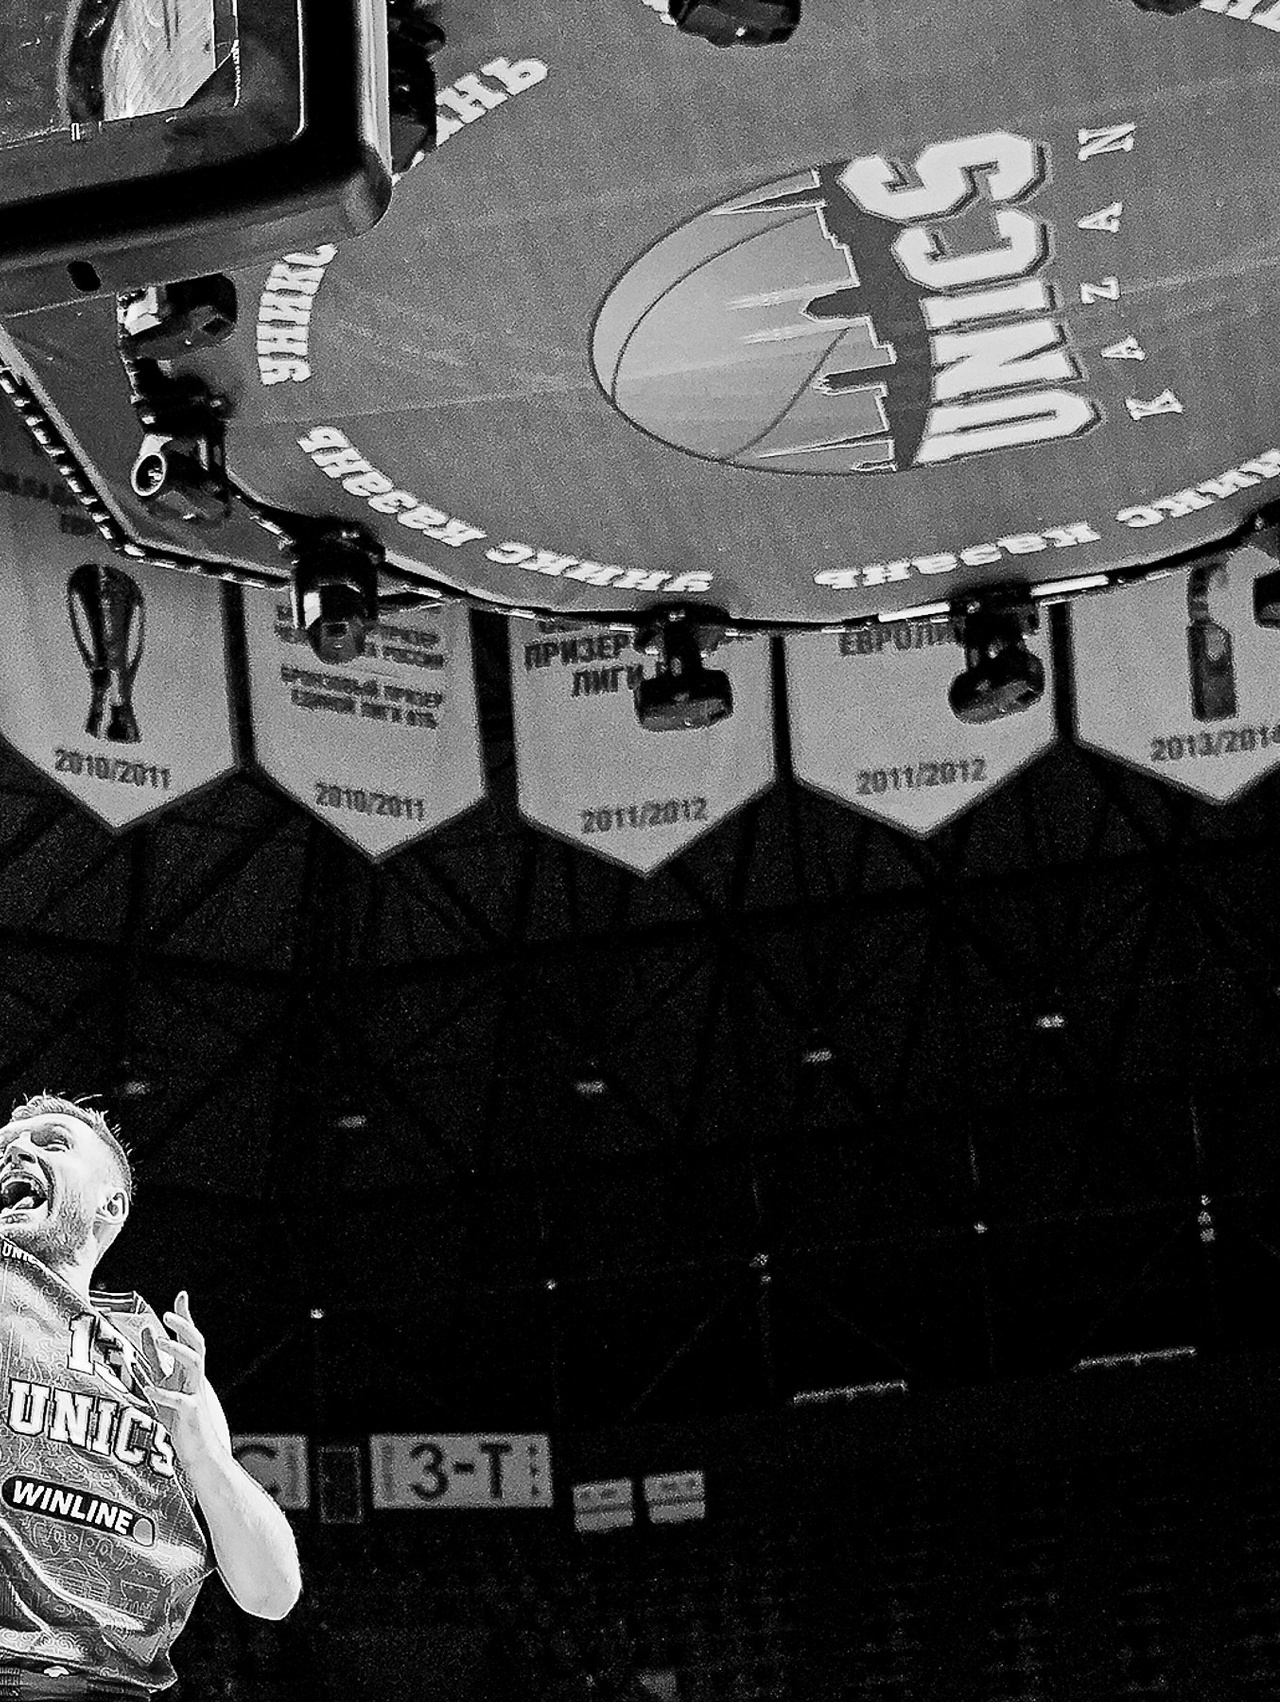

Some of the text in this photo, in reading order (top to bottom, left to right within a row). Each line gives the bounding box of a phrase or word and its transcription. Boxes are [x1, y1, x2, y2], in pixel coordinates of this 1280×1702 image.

[836, 128, 1102, 467] UNICS
[524, 633, 629, 670] ПРИЗЕР
[571, 667, 620, 697] ЛИГИ
[53, 748, 170, 790] 2010/2011
[856, 759, 987, 795] 2011/2012
[314, 780, 425, 822] 2010/2011
[580, 800, 708, 834] 2011/2012
[7, 1379, 173, 1476] UNICS
[12, 1481, 133, 1535] WINLINE
